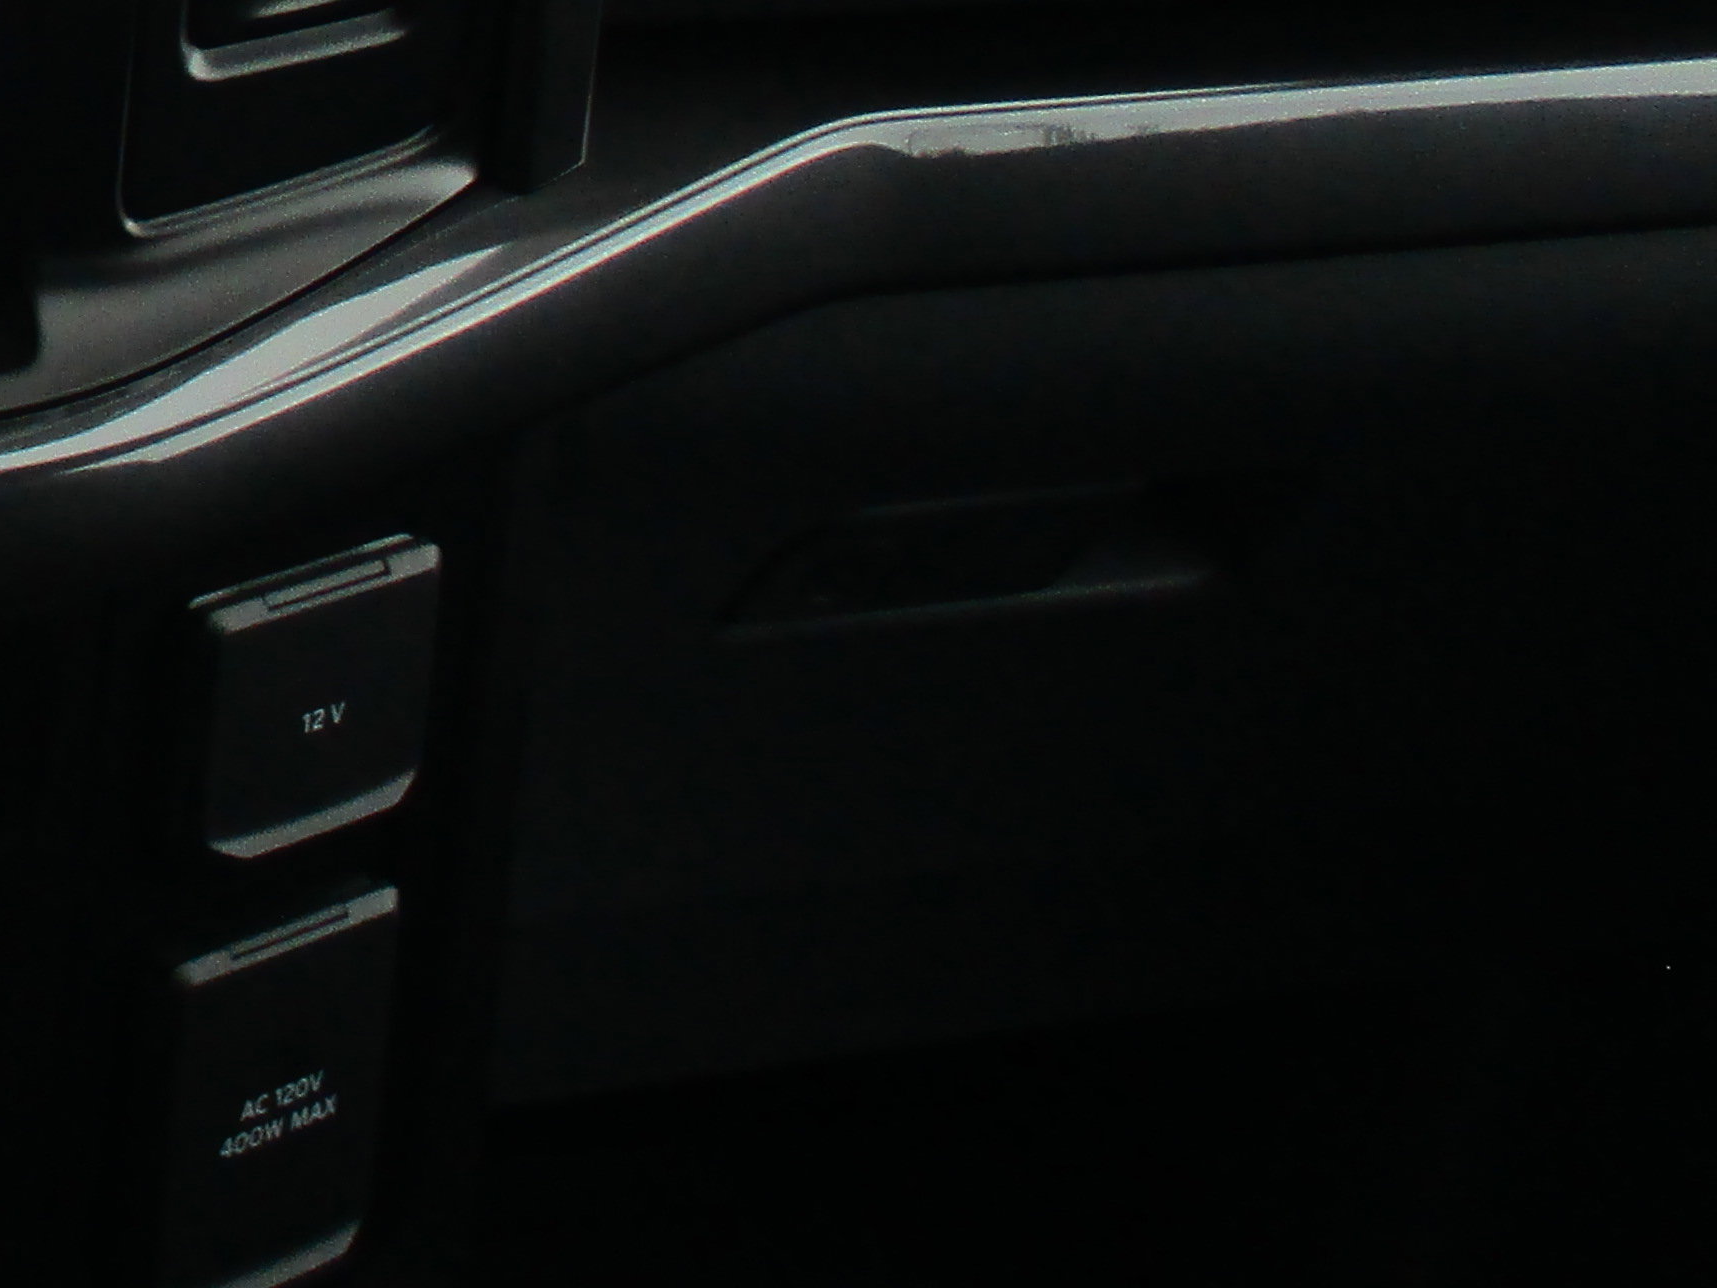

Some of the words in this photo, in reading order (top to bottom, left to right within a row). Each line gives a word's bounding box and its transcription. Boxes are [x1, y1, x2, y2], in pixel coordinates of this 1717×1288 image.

[300, 707, 326, 734] 12
[327, 701, 347, 725] V
[239, 1091, 270, 1124] AC
[273, 1069, 327, 1111] 120V
[218, 1119, 285, 1160] 400W
[290, 1095, 339, 1132] MAX
